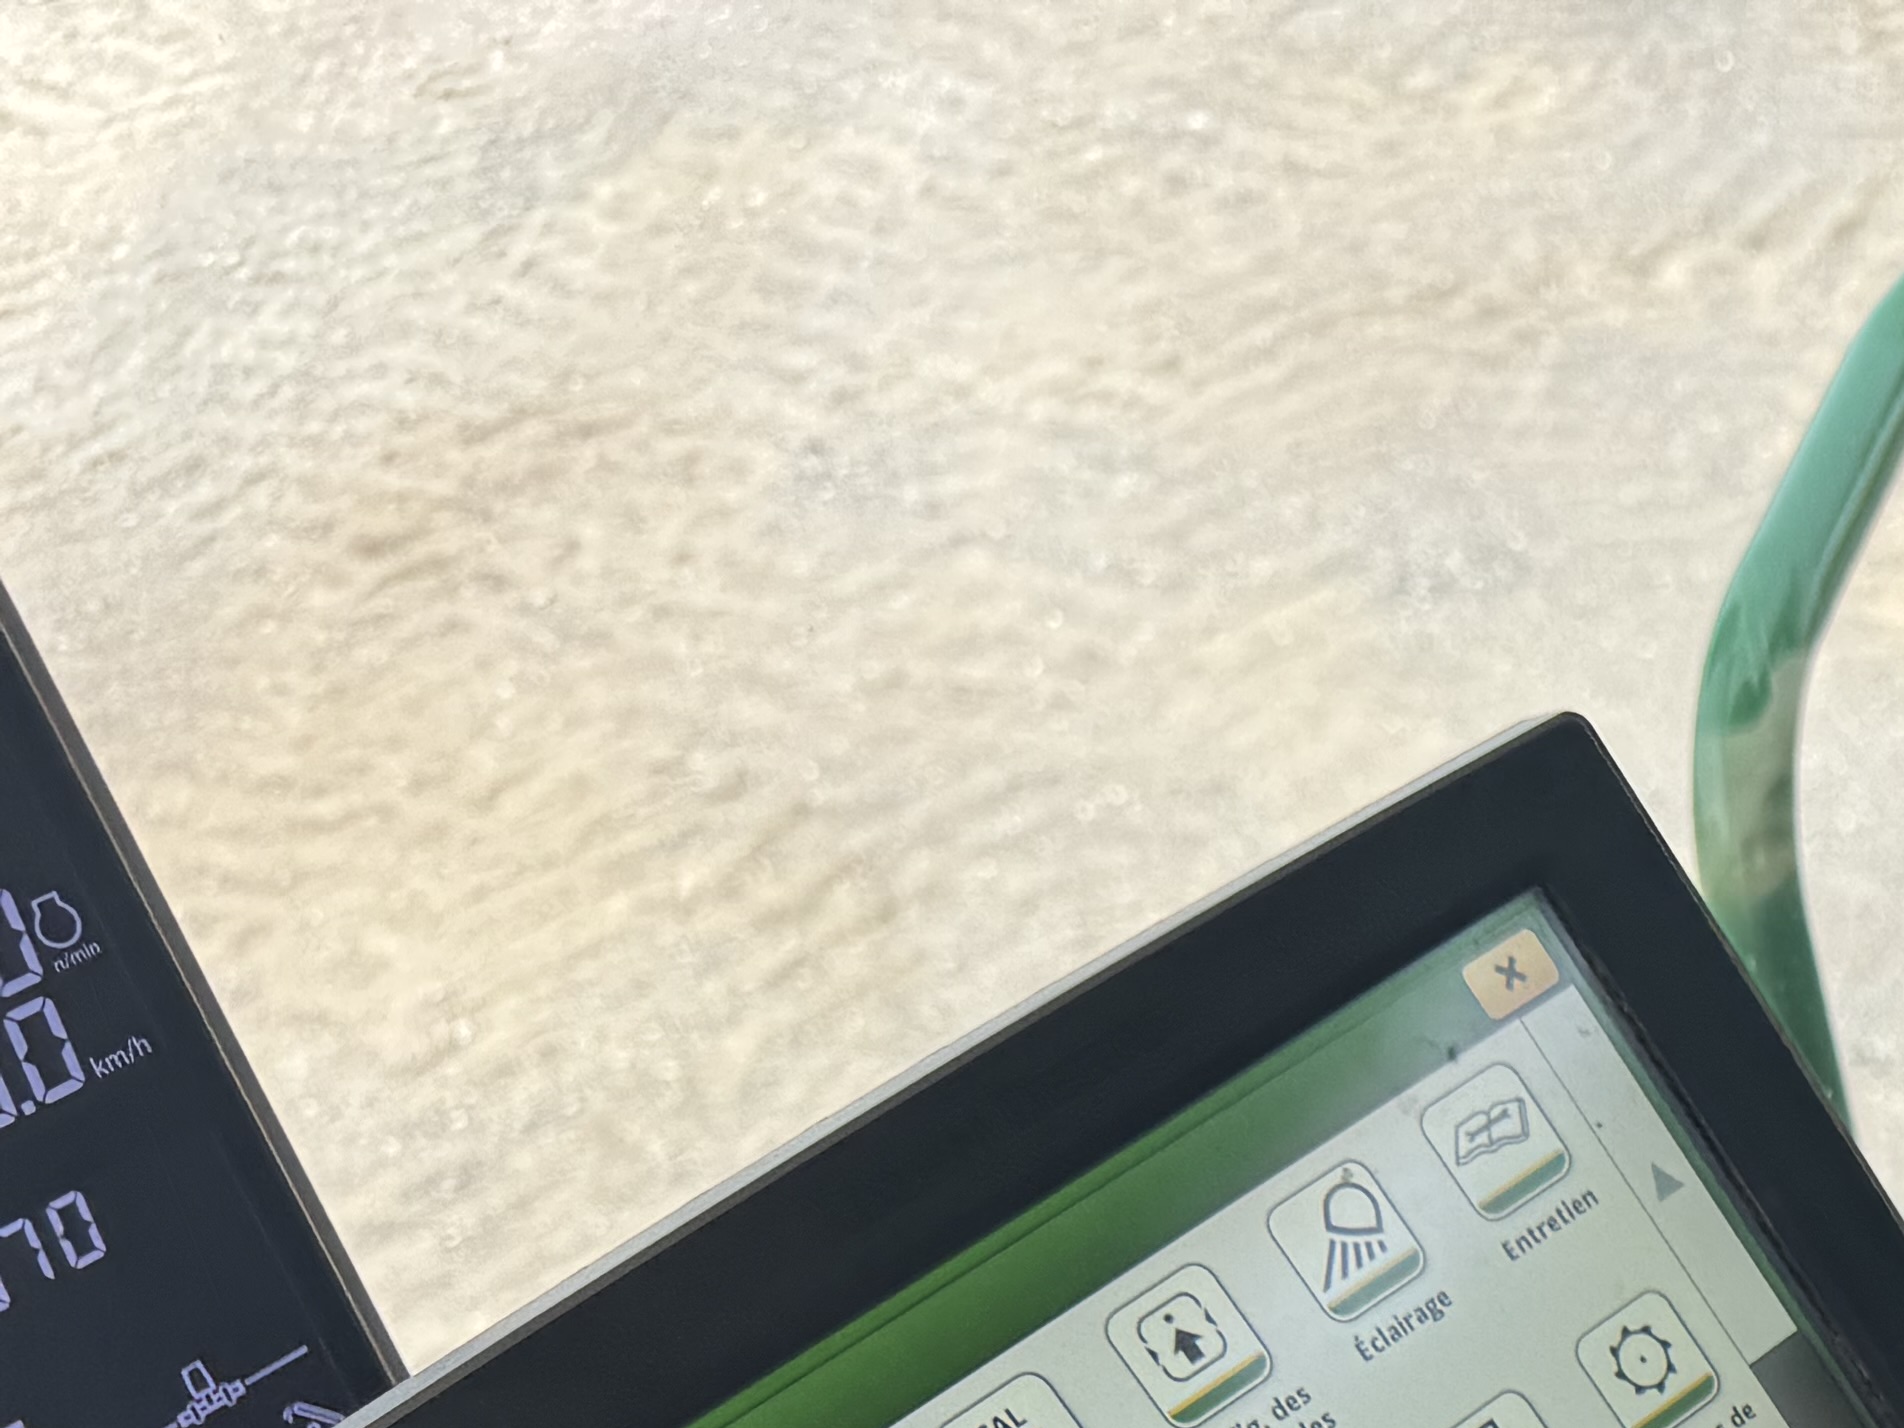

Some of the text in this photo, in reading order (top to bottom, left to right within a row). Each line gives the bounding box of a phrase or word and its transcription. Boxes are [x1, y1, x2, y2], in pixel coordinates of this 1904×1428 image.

[90, 1034, 153, 1079] km/h
[1502, 1189, 1600, 1261] Entretien
[1354, 1290, 1453, 1362] Éclairage
[1271, 1387, 1312, 1421] des
[1730, 1402, 1757, 1428] de
